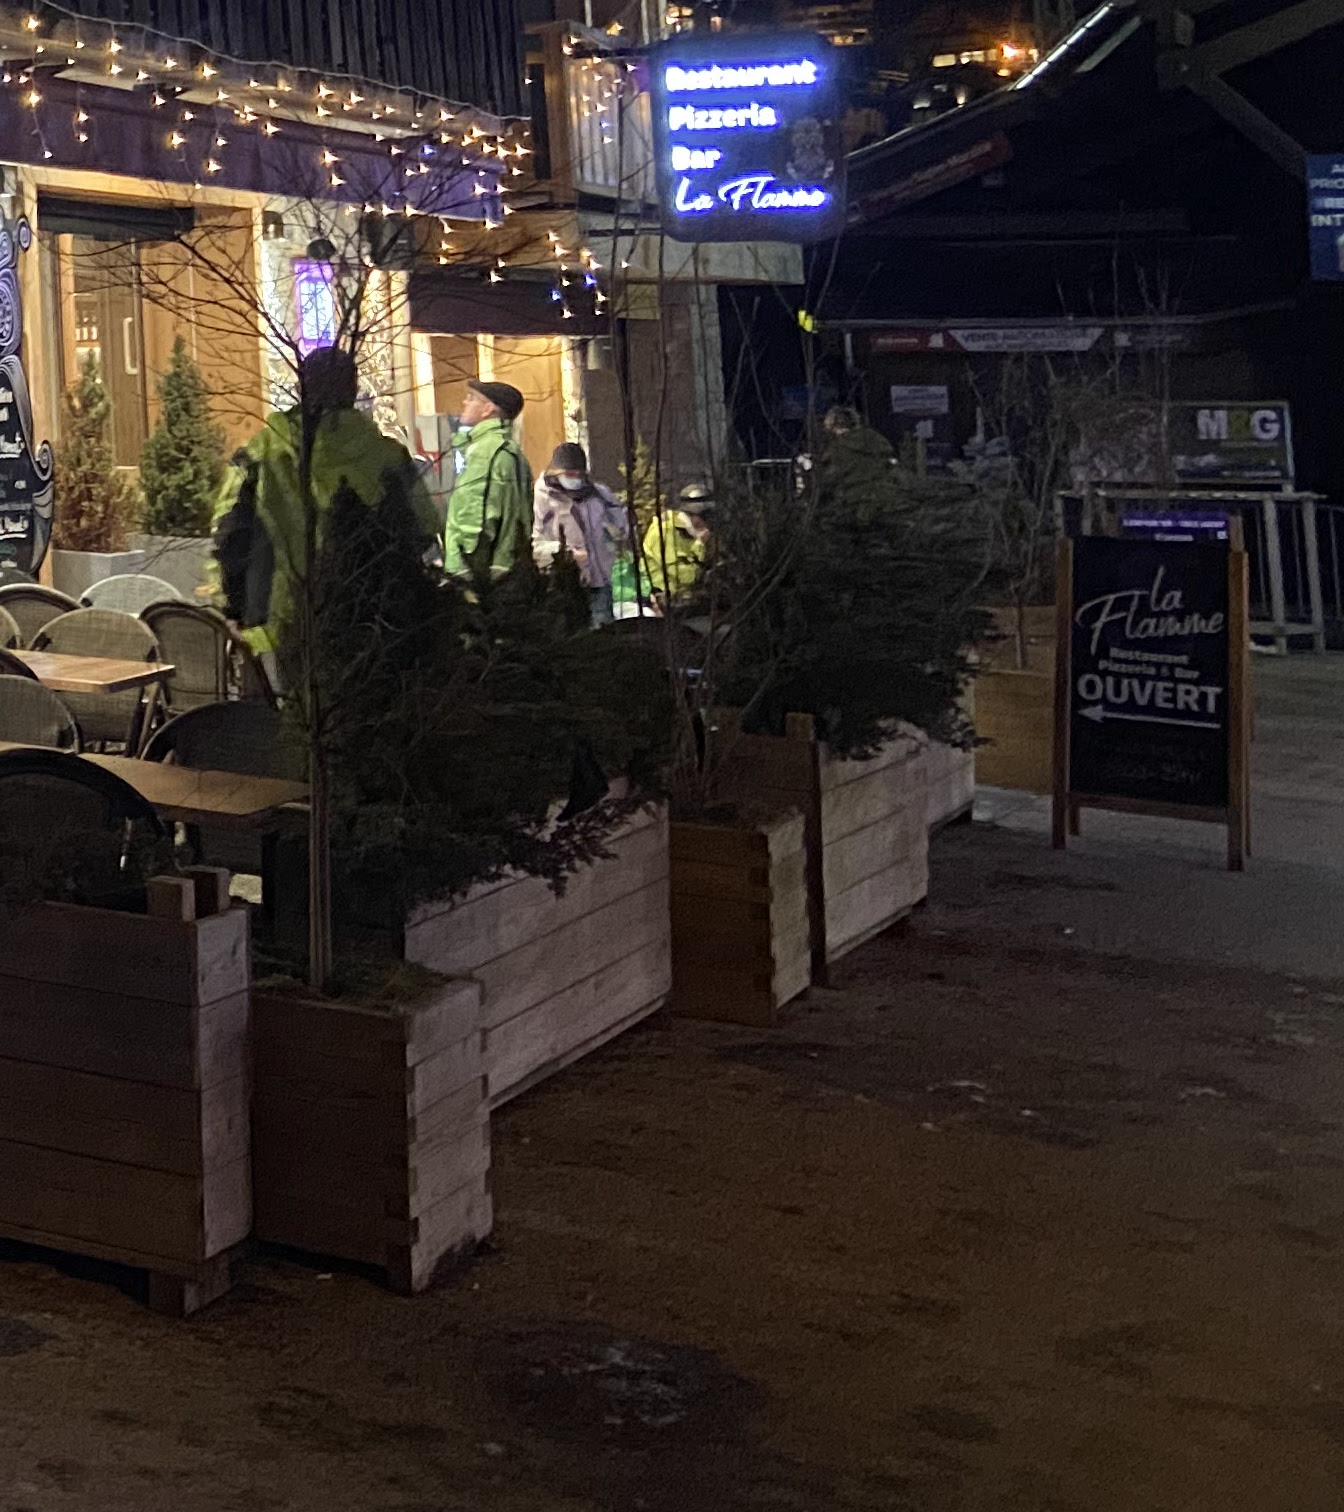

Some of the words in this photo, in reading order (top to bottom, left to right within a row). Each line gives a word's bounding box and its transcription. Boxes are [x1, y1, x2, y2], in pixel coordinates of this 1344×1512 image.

[666, 59, 817, 91] Restaurant
[669, 101, 776, 131] Pizzeria
[671, 146, 721, 170] Bar
[675, 176, 714, 211] La
[718, 176, 826, 211] Flamme
[1075, 590, 1224, 656] Flamme
[1077, 673, 1222, 713] OUVERT
